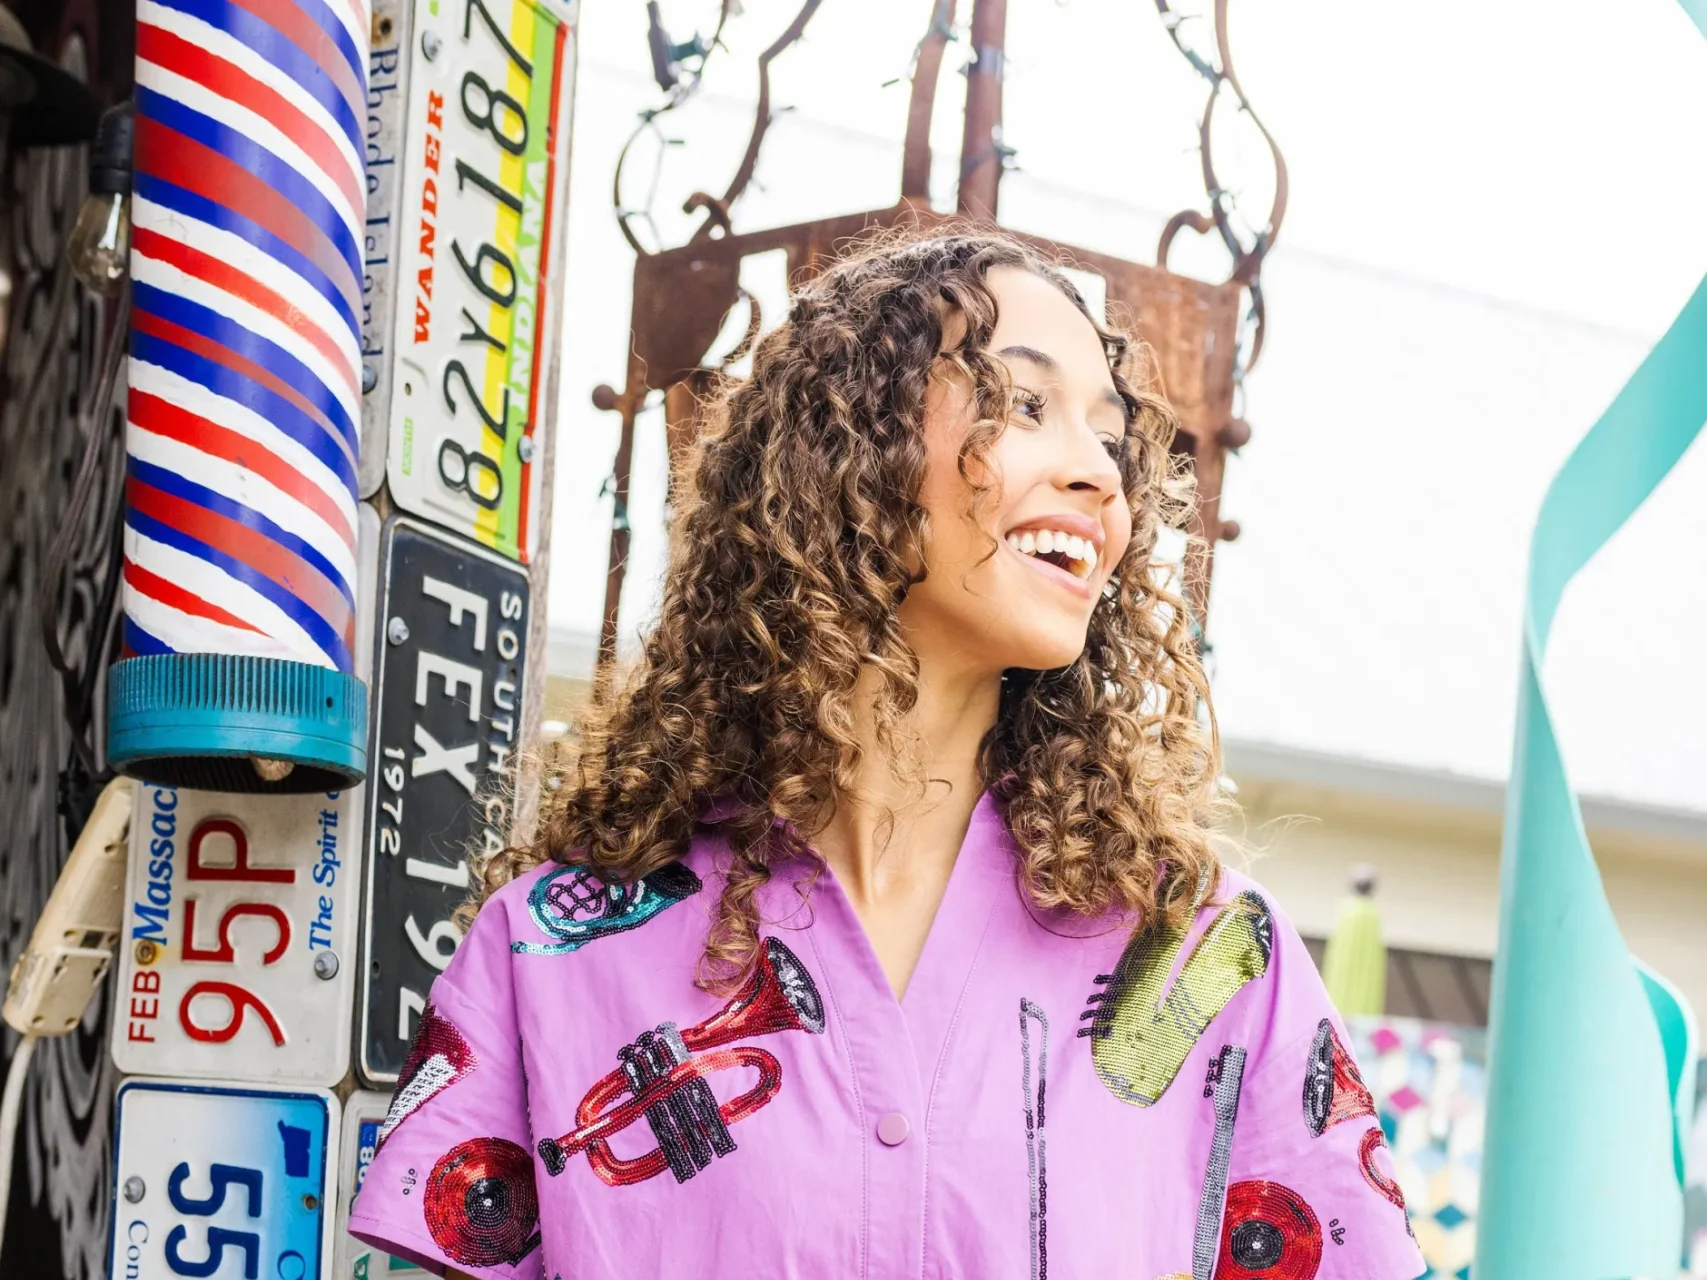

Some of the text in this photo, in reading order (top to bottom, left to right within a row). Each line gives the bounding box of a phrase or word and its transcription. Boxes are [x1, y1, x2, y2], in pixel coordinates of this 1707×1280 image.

[414, 89, 443, 344] WANDER
[437, 0, 534, 511] 82Y6187
[506, 160, 547, 412] INDIANA
[411, 575, 489, 794] FEX
[488, 590, 522, 775] SOUTH
[132, 781, 178, 946] Massac
[312, 809, 341, 888] Spirit
[380, 748, 406, 856] 1972
[128, 970, 160, 1043] FEB
[179, 819, 296, 1047] 95P
[309, 896, 334, 950] The
